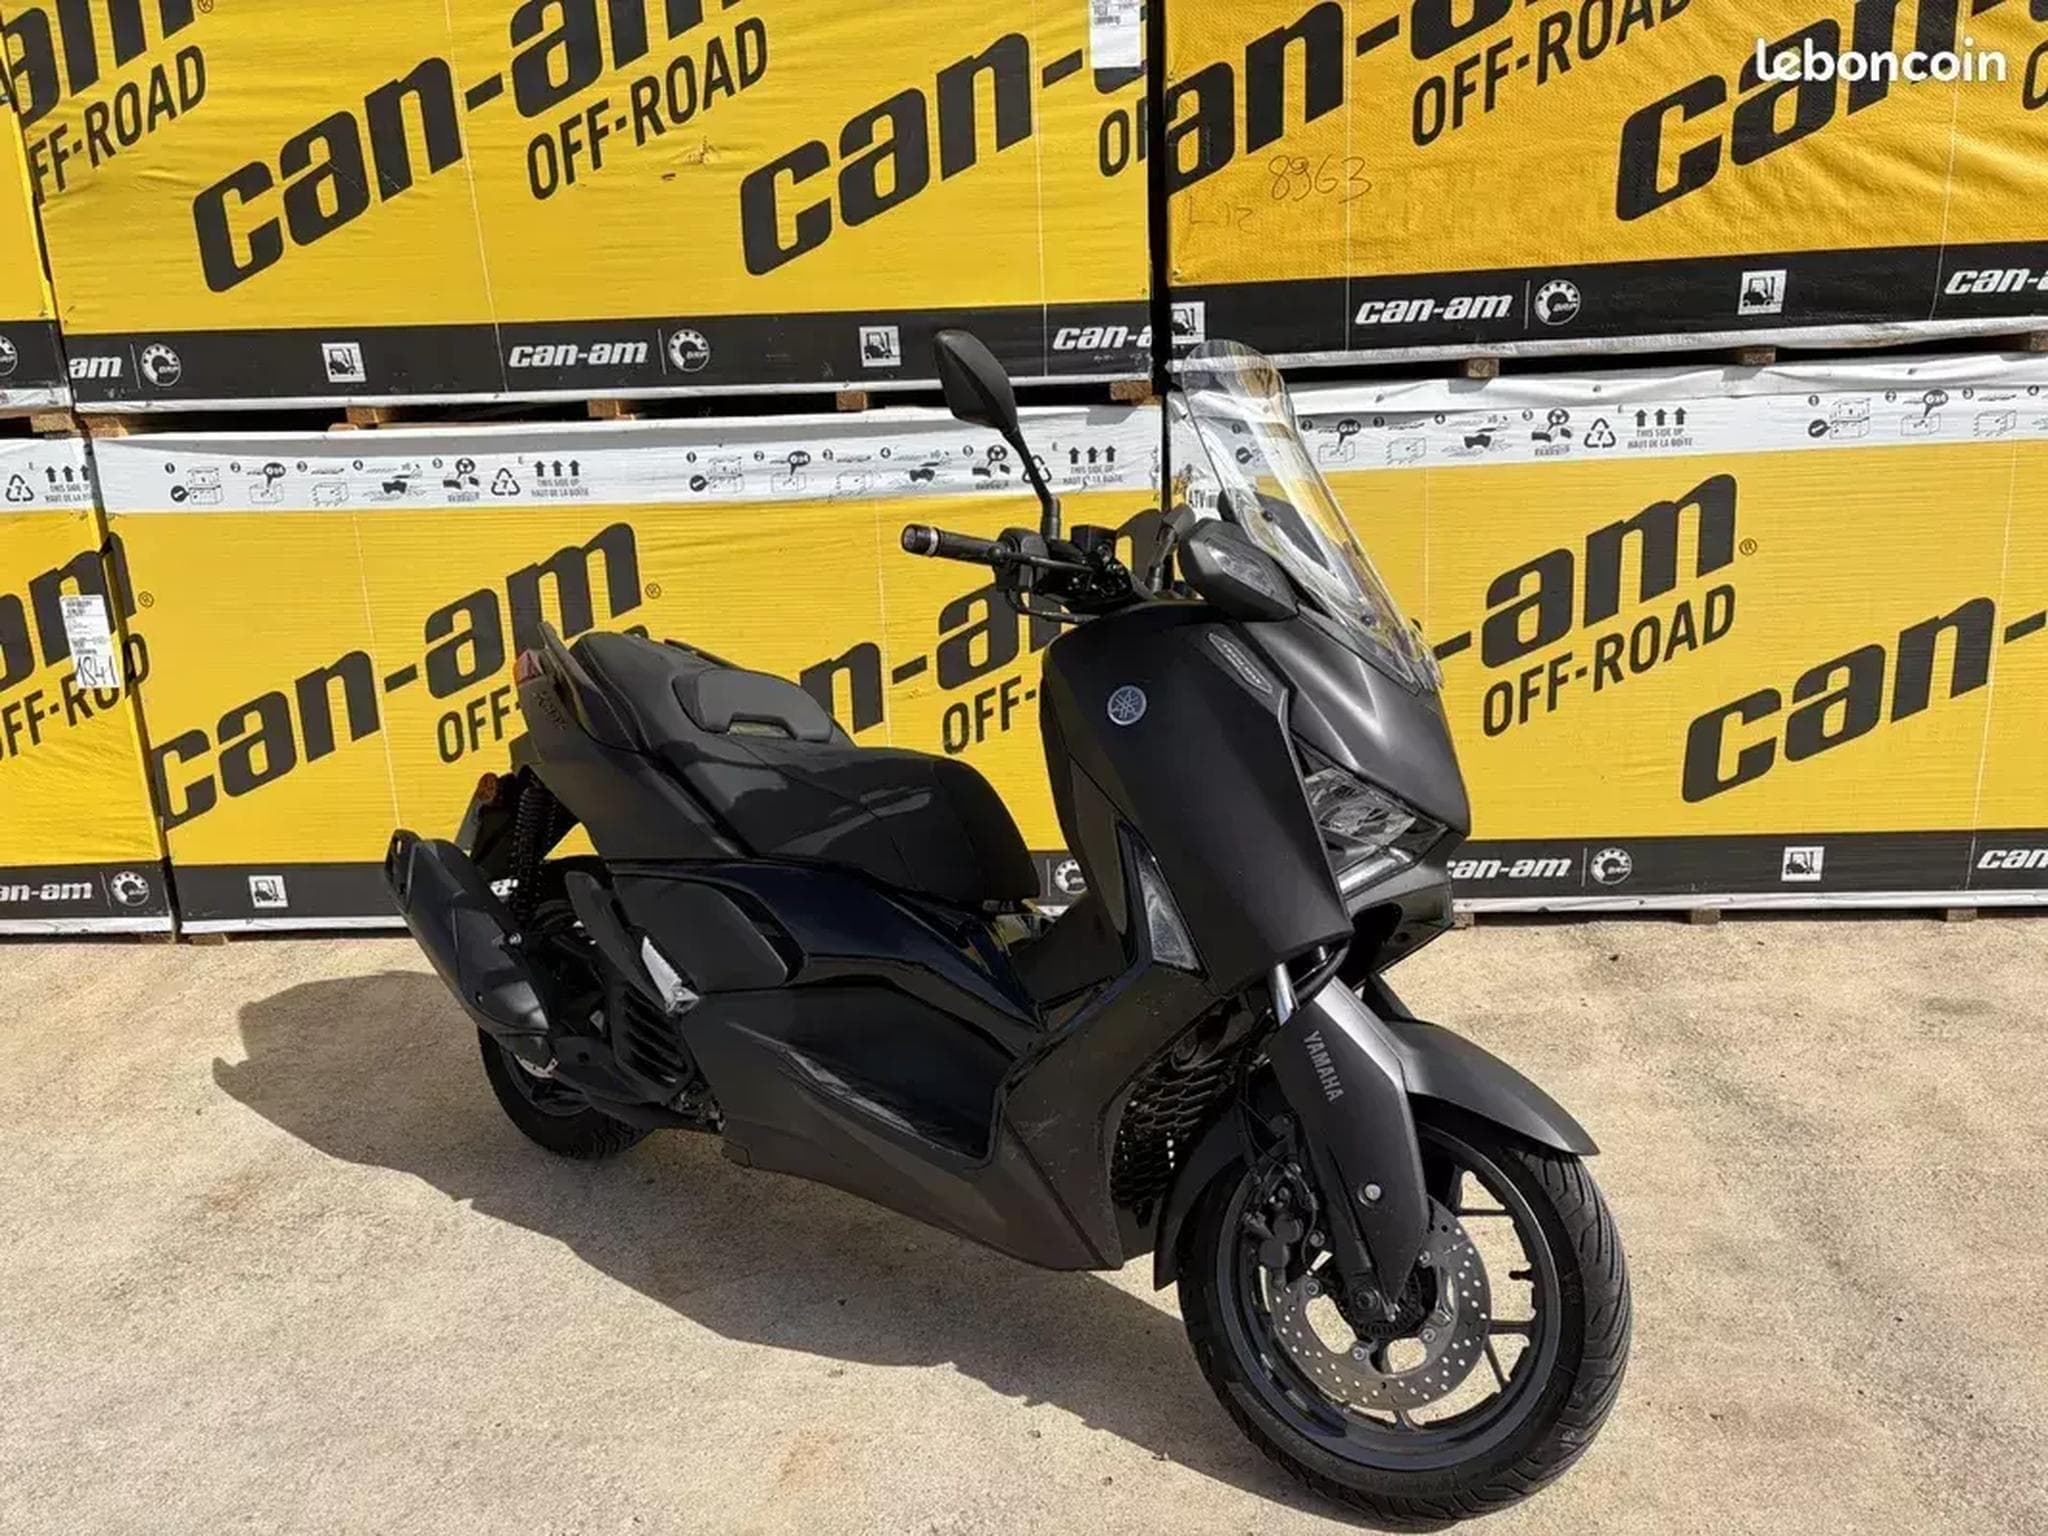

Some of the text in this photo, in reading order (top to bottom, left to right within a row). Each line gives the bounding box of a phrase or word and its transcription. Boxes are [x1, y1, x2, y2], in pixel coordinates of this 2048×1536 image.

[527, 16, 768, 200] OFF-ROAD
[1268, 153, 1372, 204] 8963
[1355, 294, 1513, 325] can-am
[508, 341, 649, 369] can-am
[1483, 583, 1736, 737] OFF-ROAD
[1303, 1030, 1344, 1102] YAMAHA
